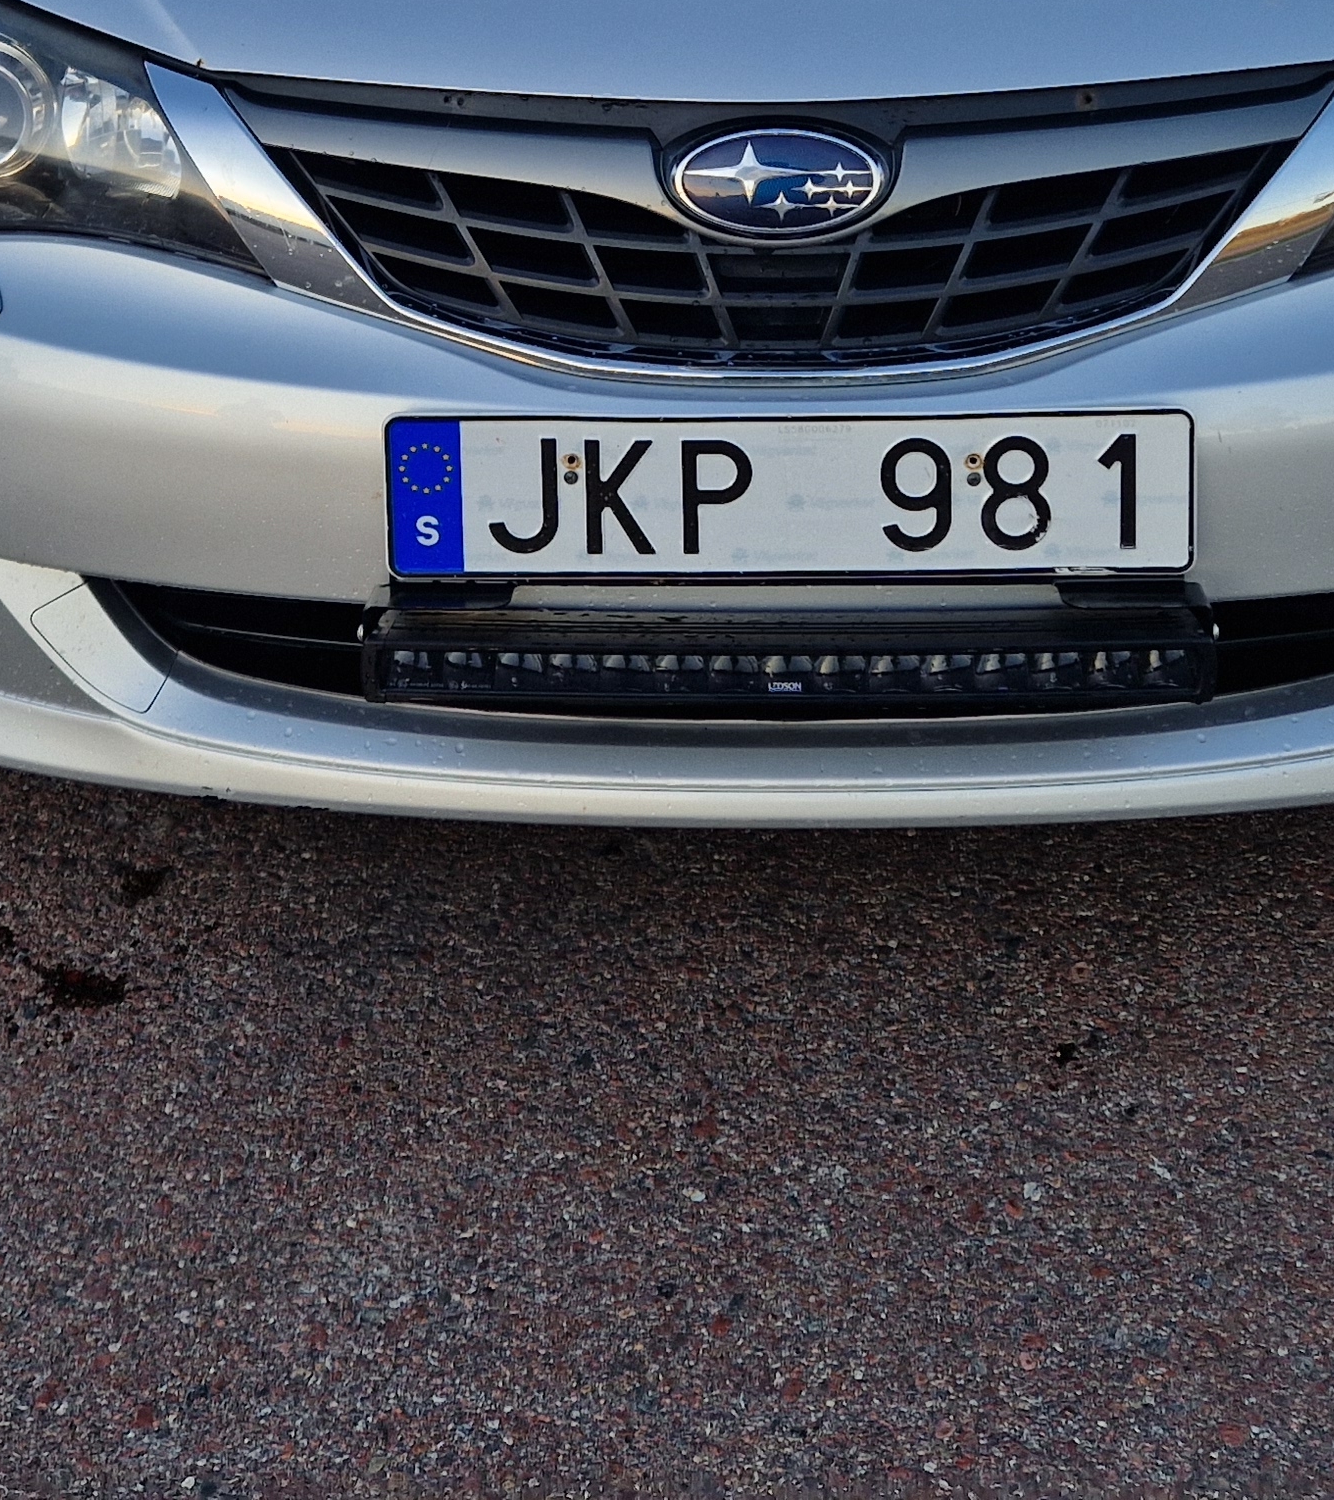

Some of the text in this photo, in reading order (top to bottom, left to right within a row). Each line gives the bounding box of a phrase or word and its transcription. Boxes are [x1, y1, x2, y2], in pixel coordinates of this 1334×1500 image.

[415, 515, 440, 547] S
[488, 433, 1136, 555] JKP 981
